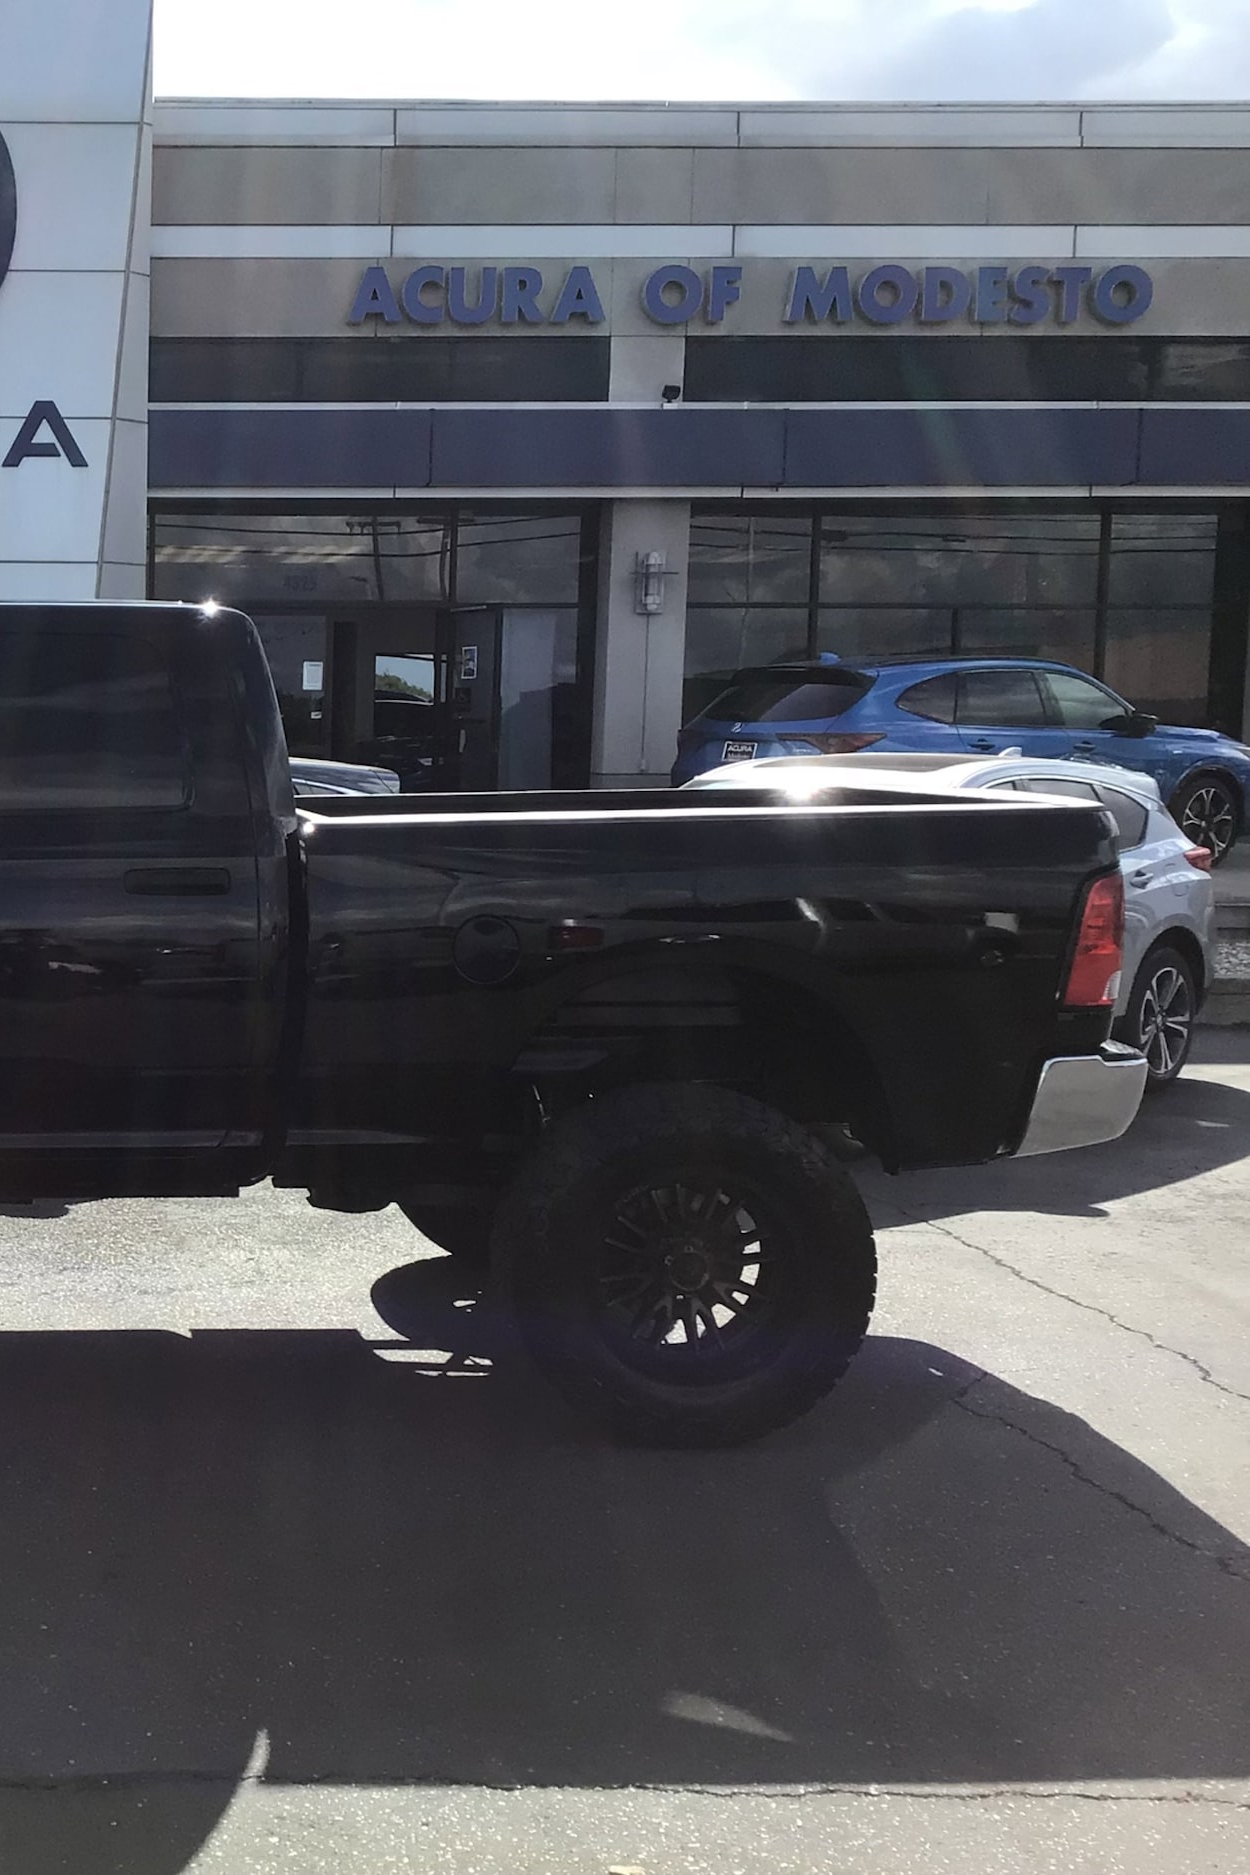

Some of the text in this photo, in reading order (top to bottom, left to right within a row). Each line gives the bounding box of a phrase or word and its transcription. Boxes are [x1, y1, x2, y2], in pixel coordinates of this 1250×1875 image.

[348, 264, 1154, 325] ACURA OF MODESTO
[727, 744, 752, 752] ACURA
